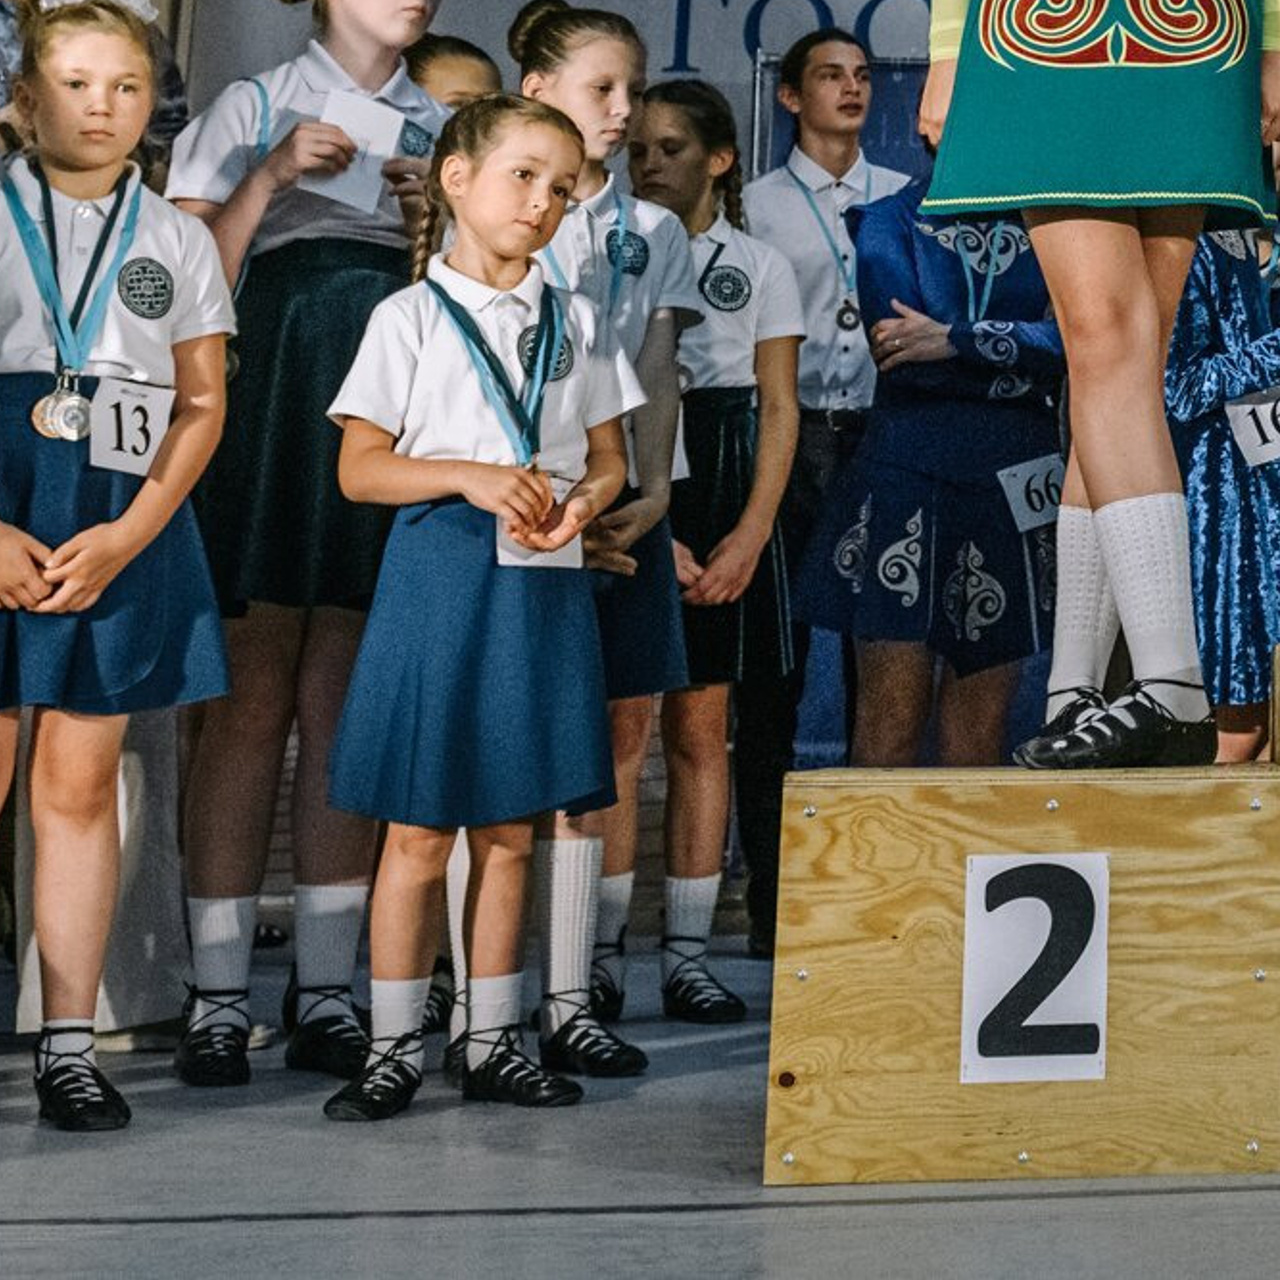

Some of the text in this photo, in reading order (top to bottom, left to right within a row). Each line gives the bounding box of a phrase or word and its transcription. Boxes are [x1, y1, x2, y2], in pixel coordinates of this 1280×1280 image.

[108, 401, 152, 458] 13
[1023, 466, 1062, 514] 66
[977, 862, 1101, 1059] 2
